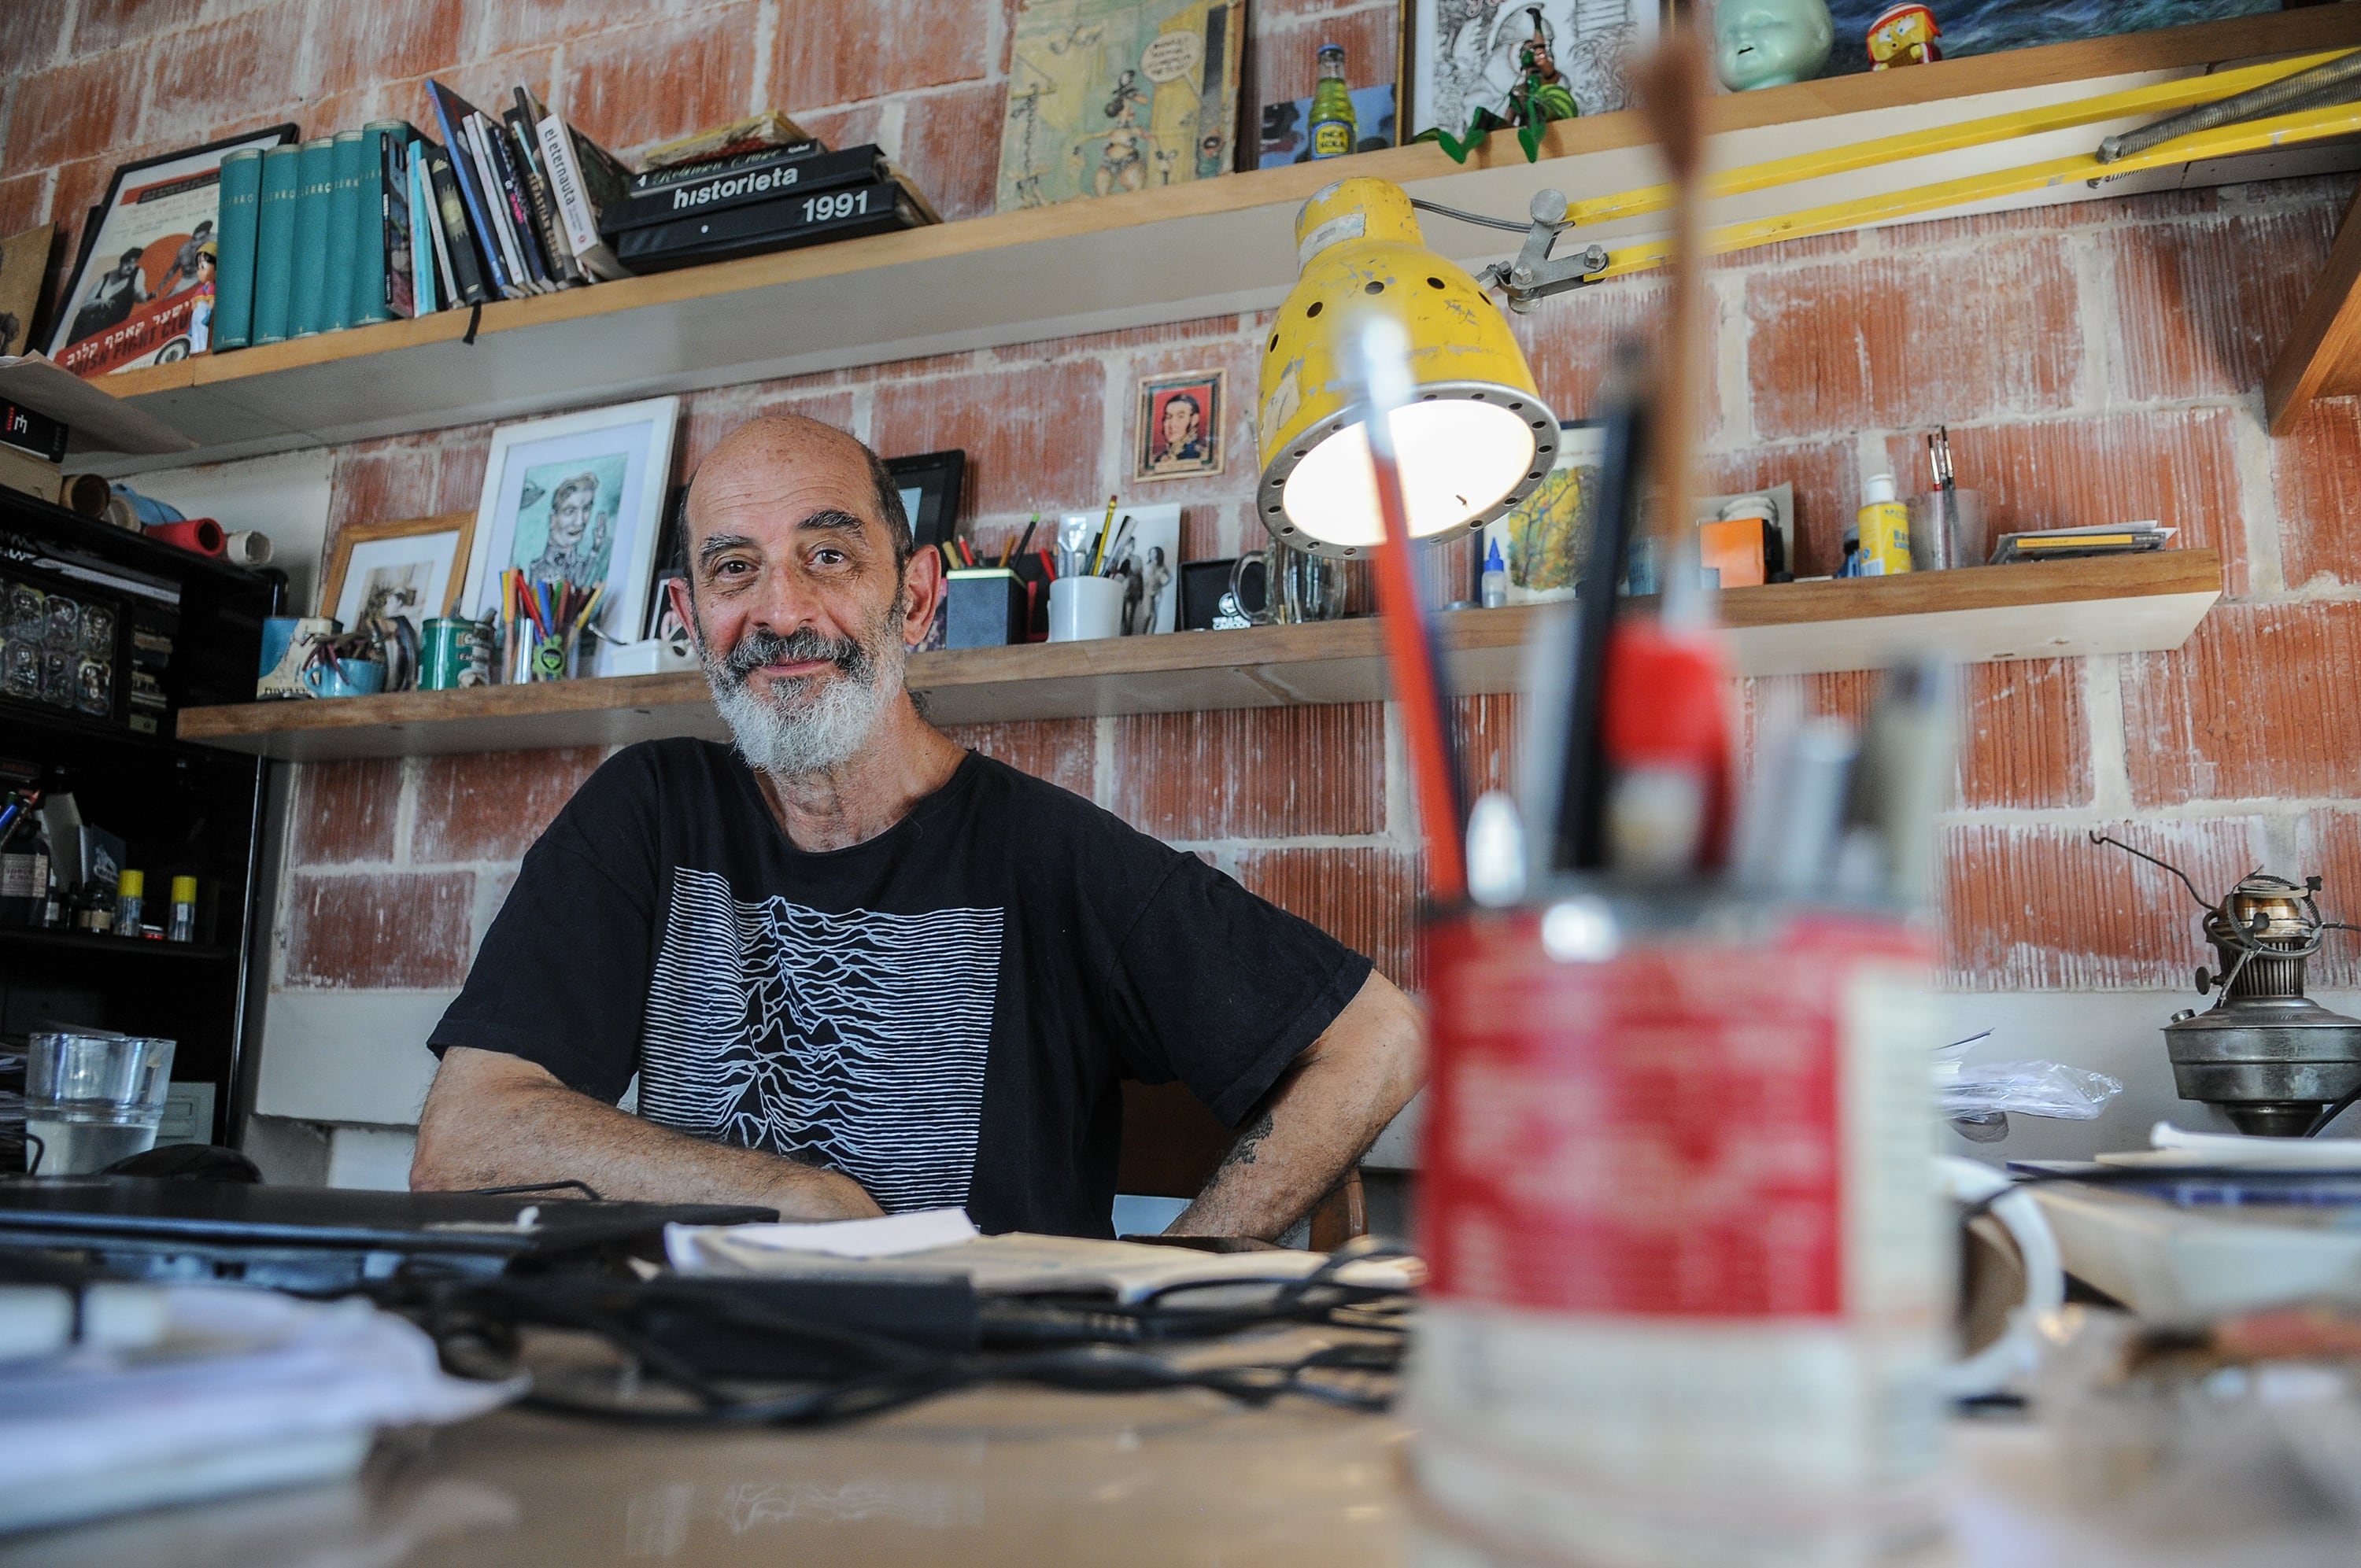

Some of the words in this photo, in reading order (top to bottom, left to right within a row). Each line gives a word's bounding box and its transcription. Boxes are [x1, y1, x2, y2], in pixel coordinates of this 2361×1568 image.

[545, 128, 555, 142] el
[549, 142, 576, 206] eternauta
[673, 166, 798, 209] historieta
[802, 190, 869, 223] 1991
[161, 310, 191, 338] CLU
